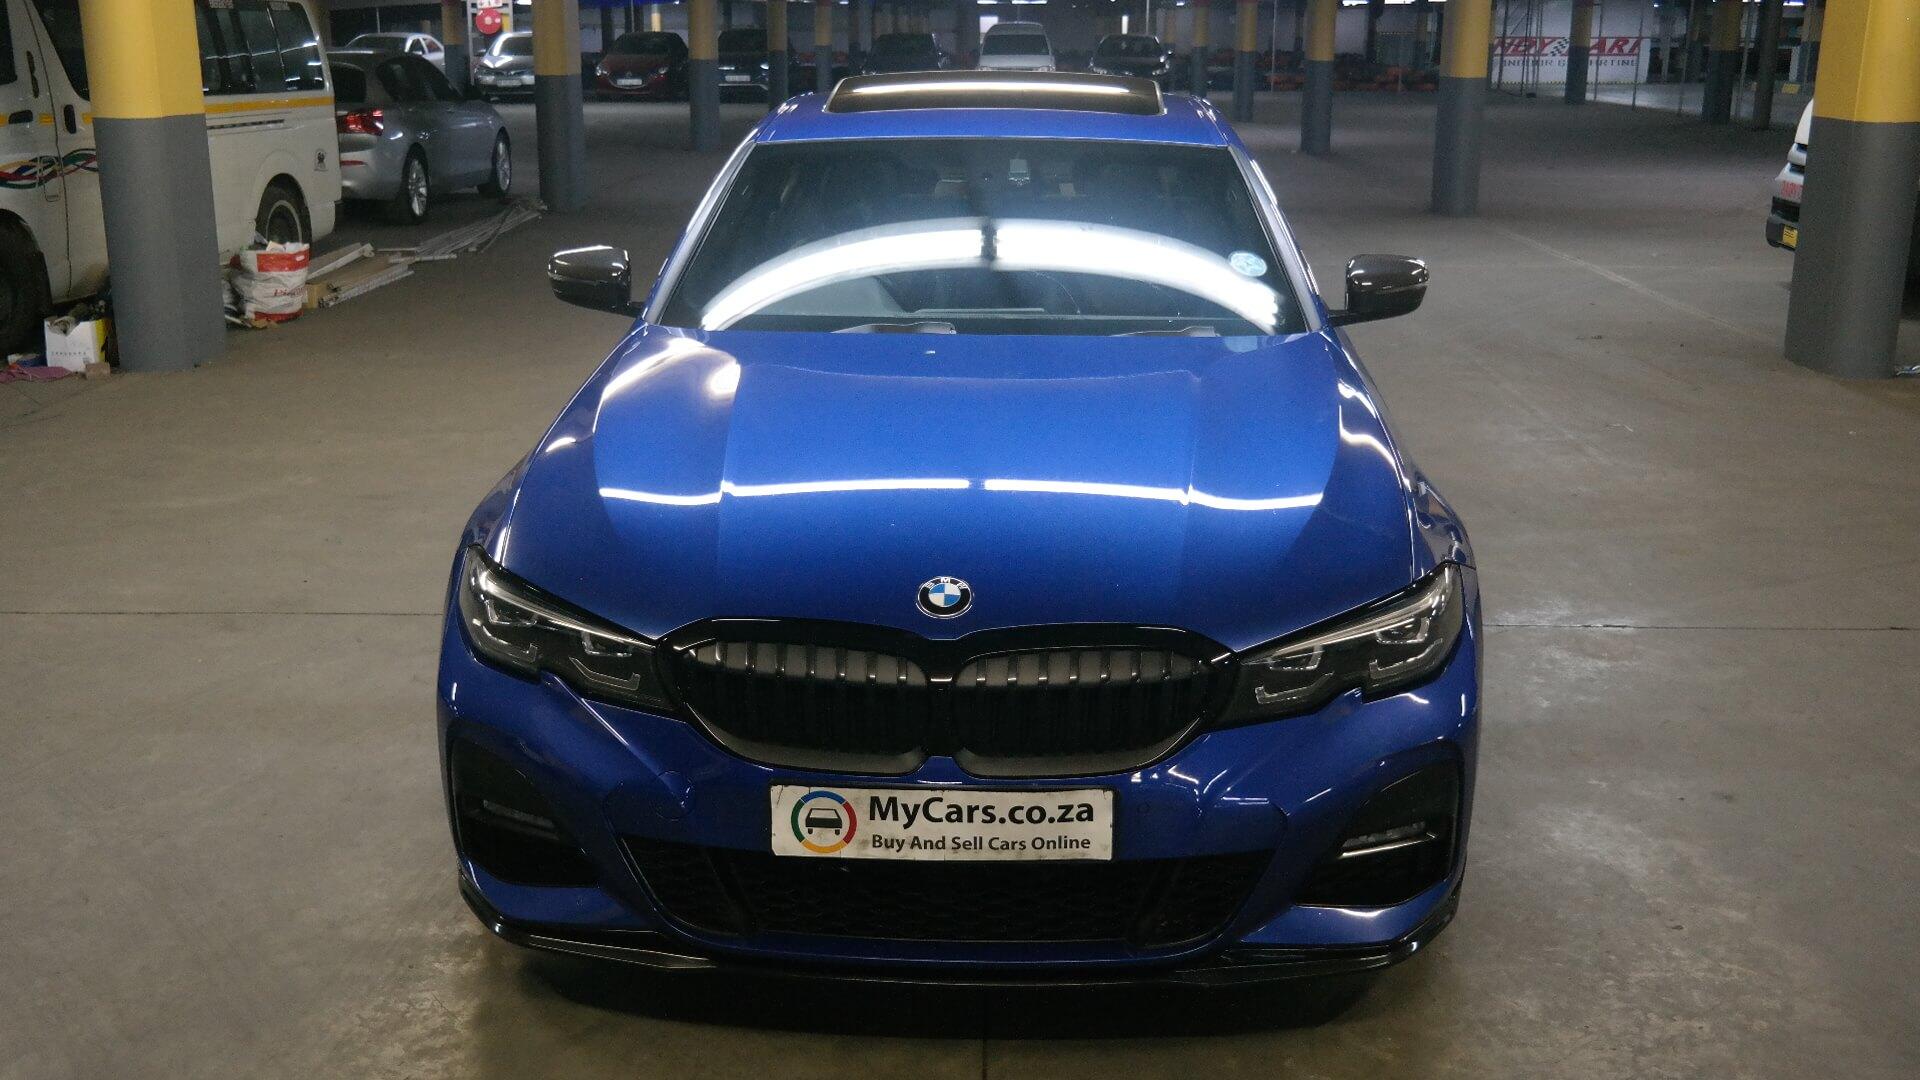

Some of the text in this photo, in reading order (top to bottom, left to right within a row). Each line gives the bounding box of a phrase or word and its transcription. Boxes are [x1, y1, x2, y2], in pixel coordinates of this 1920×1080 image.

[869, 796, 1094, 829] MyCars.co.za
[872, 834, 1091, 852] Buy And Sell Cars Online
